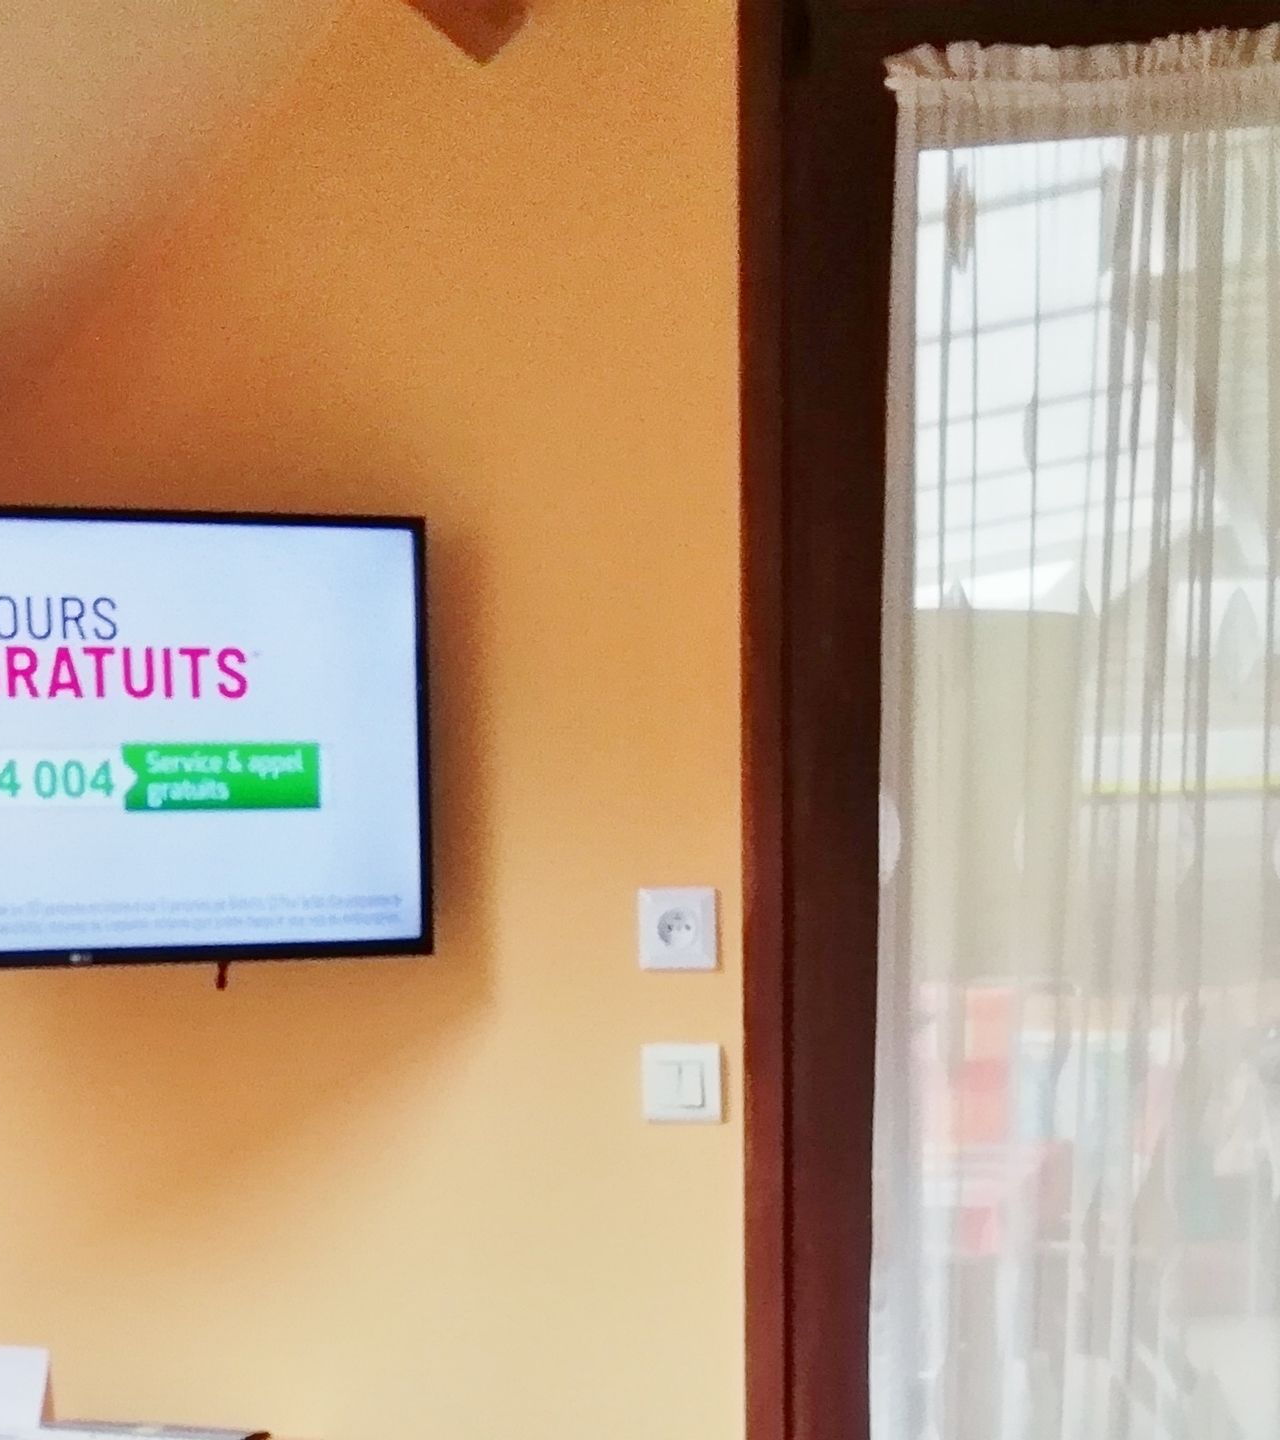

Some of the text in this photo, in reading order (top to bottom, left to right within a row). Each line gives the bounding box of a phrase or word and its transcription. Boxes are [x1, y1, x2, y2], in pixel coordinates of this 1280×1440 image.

[34, 758, 114, 798] 004
[145, 749, 304, 780] Service & appel
[146, 777, 230, 808] gratuits
